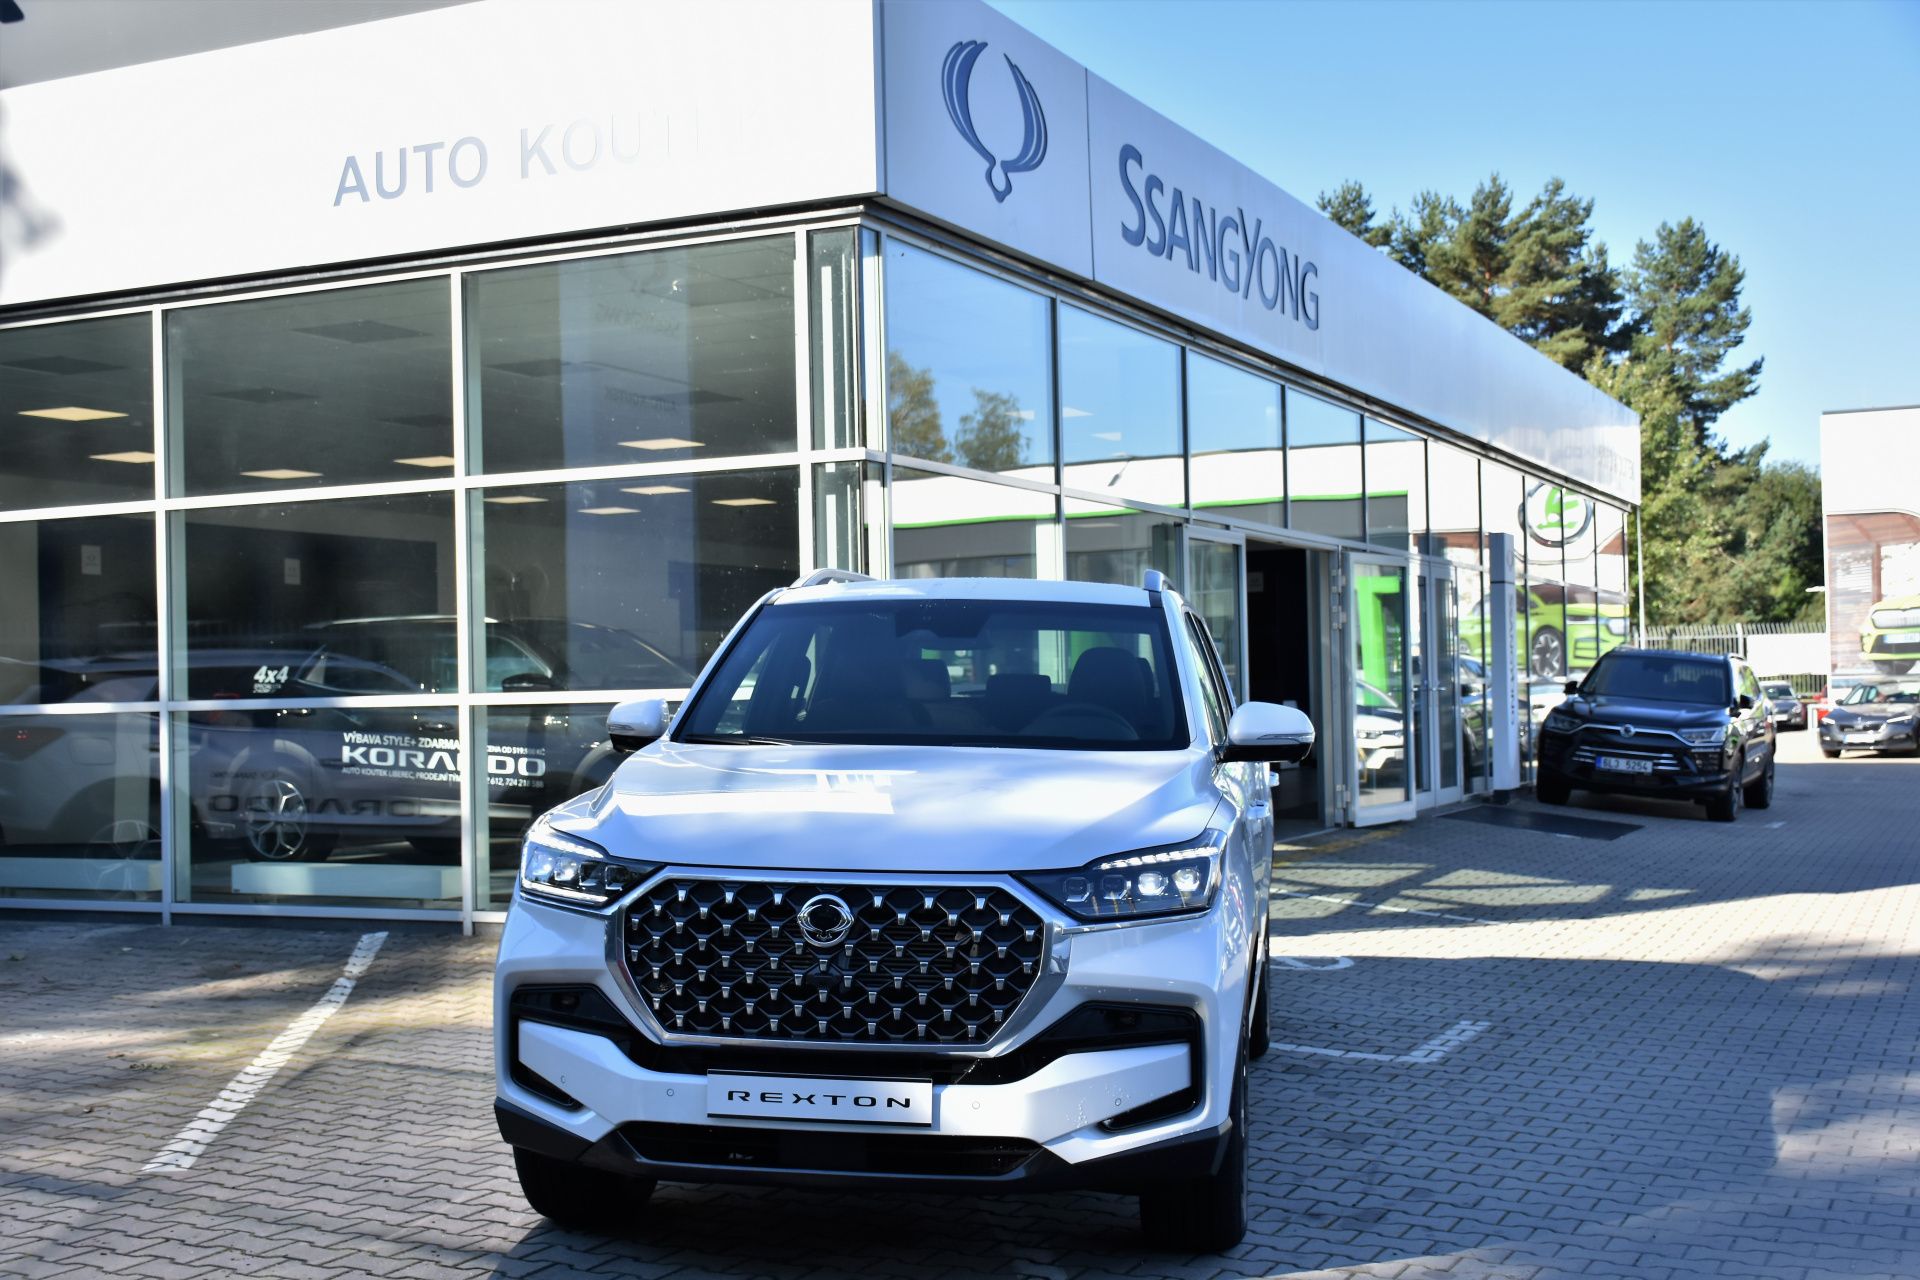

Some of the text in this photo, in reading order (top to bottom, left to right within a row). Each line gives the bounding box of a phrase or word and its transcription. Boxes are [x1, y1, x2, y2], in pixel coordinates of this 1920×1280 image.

[333, 136, 489, 207] AUTO
[1119, 143, 1319, 331] SSANGYONG
[253, 665, 289, 683] 4x4
[343, 731, 460, 750] VÝBAVA STYLE+ ZDARMA
[341, 745, 546, 777] KORADO
[342, 767, 360, 775] AUTO
[361, 768, 388, 777] KOUTEK
[727, 1090, 911, 1109] REXTON
